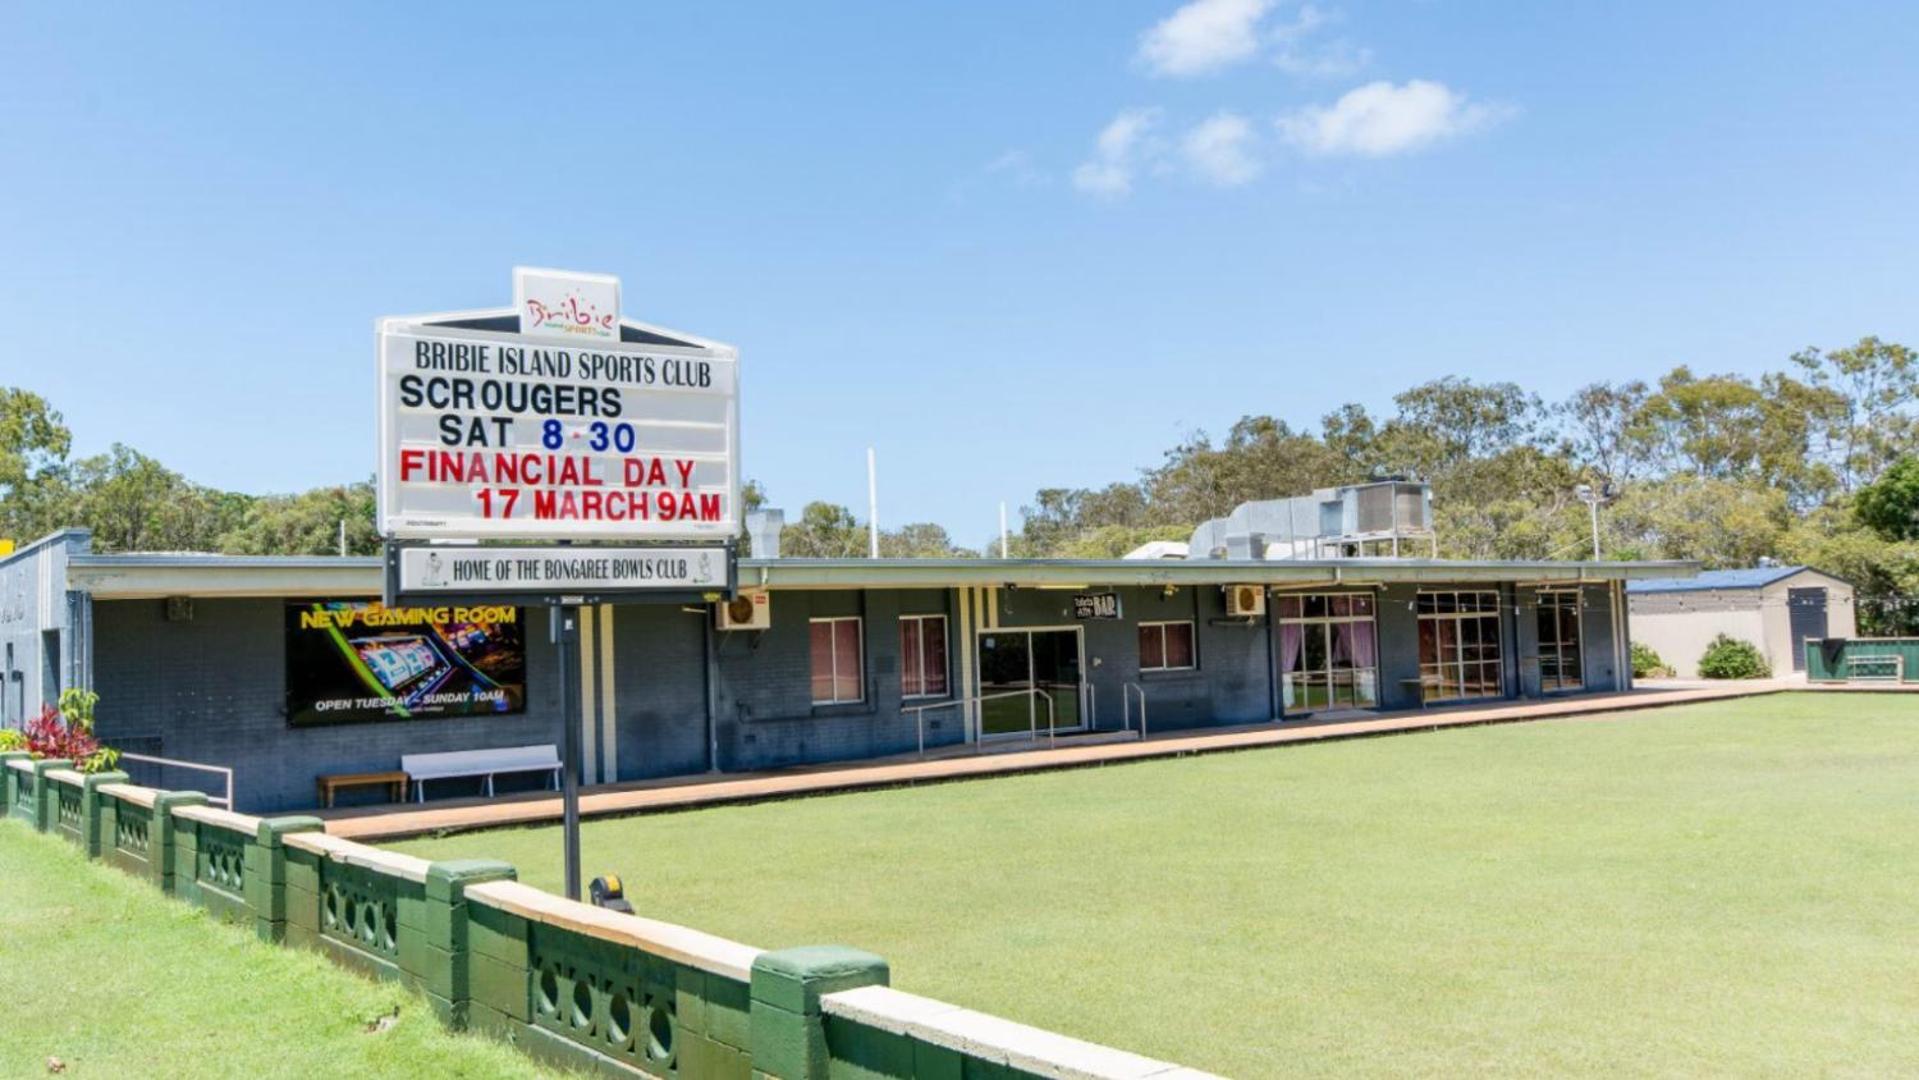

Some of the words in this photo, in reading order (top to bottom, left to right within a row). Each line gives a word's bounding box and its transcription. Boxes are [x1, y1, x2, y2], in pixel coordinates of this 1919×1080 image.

[526, 297, 614, 330] Bribie
[415, 340, 491, 375] BRIBIE
[498, 346, 572, 380] ISLAND
[578, 352, 656, 386] SPORTS
[662, 358, 712, 389] CLUB
[400, 375, 623, 418] SCROUGERS
[439, 413, 514, 448] SAT
[400, 449, 604, 487] FINANCIAL
[624, 457, 695, 489] DAY
[476, 488, 520, 520] 17
[534, 489, 649, 521] MARCH
[656, 491, 722, 522] 9AM
[453, 559, 493, 582] HOME
[496, 559, 513, 581] OF
[516, 559, 542, 581] THE
[545, 558, 609, 581] BONGAREE
[612, 558, 653, 580] BOWLS
[656, 557, 688, 579] CLUB
[301, 608, 355, 629] NEW
[363, 606, 450, 626] GAMING
[455, 606, 516, 625] ROOM
[315, 700, 351, 712] OPEN
[355, 696, 410, 710] TUESDAY
[423, 692, 470, 705] SUNDAY
[473, 690, 504, 702] 10AM
